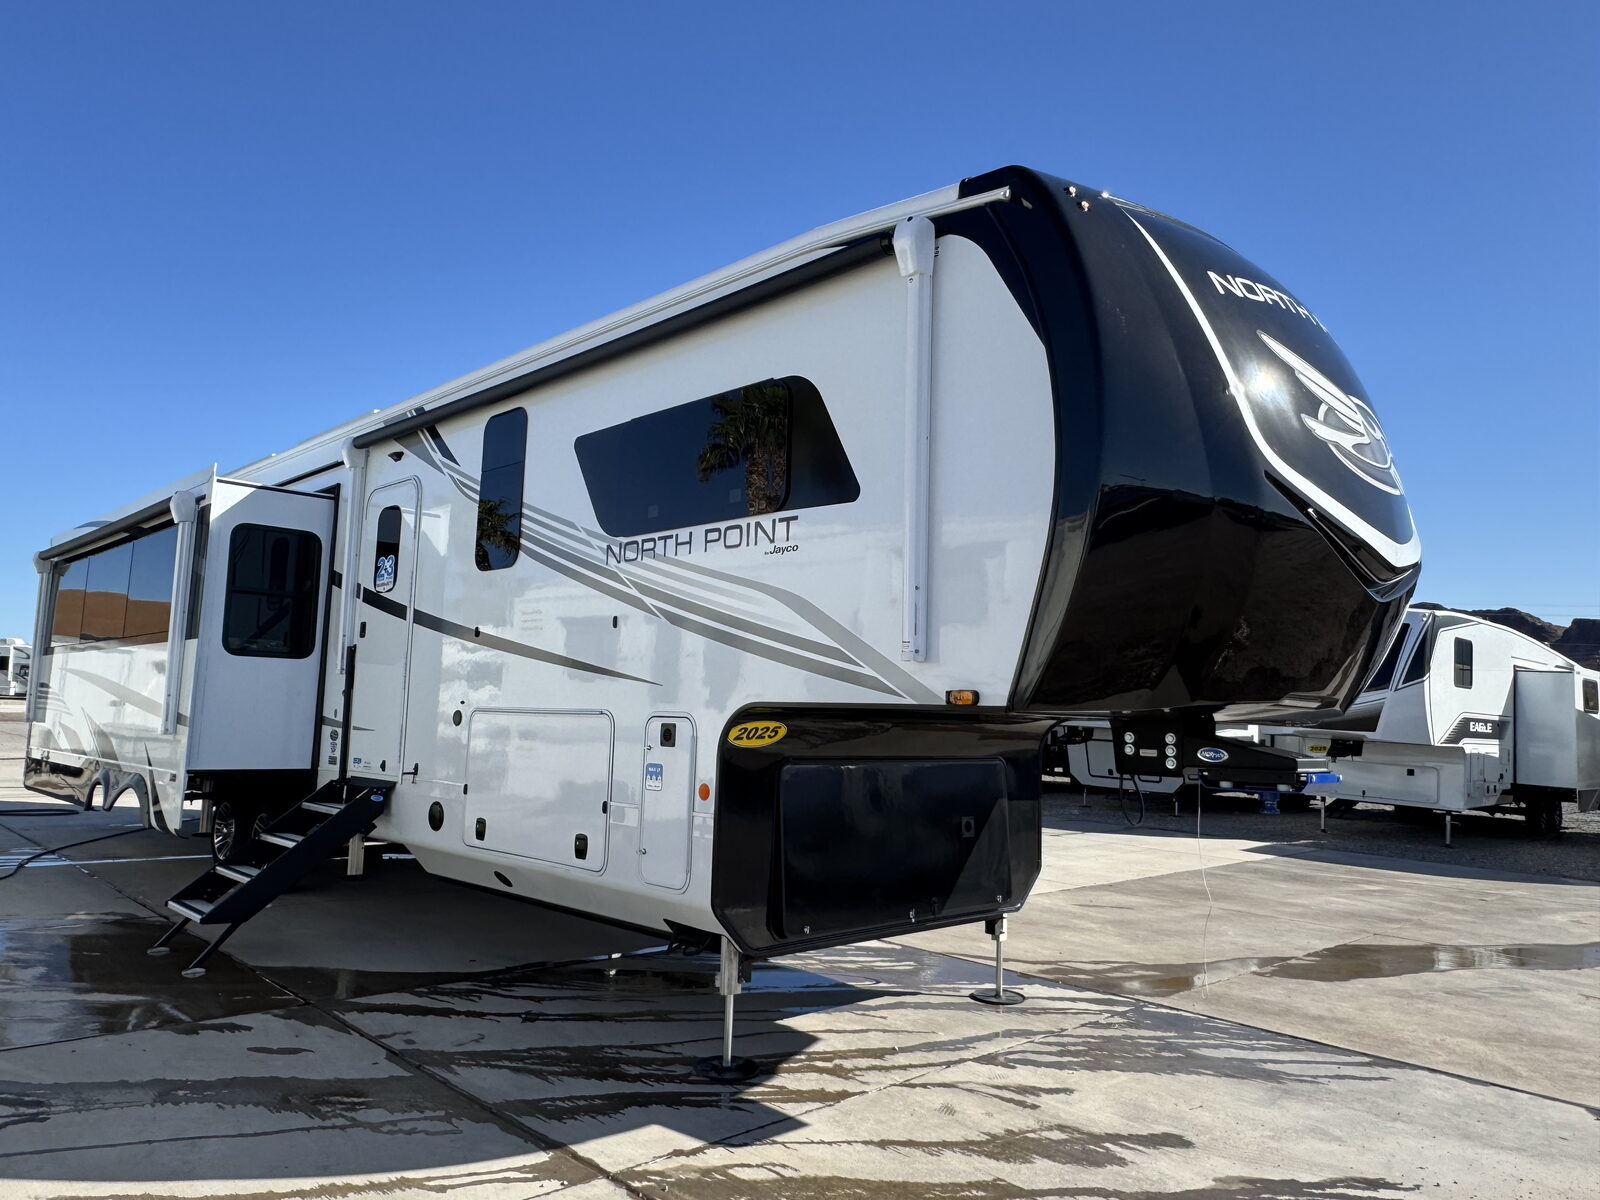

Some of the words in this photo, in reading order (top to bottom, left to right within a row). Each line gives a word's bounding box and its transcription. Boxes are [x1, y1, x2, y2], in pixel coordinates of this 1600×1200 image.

[1207, 270, 1317, 326] NORTH
[605, 531, 693, 566] NORTH
[704, 515, 799, 552] POINT
[770, 544, 799, 555] Jayco
[733, 725, 782, 741] 2025
[1469, 721, 1493, 733] EAGLE
